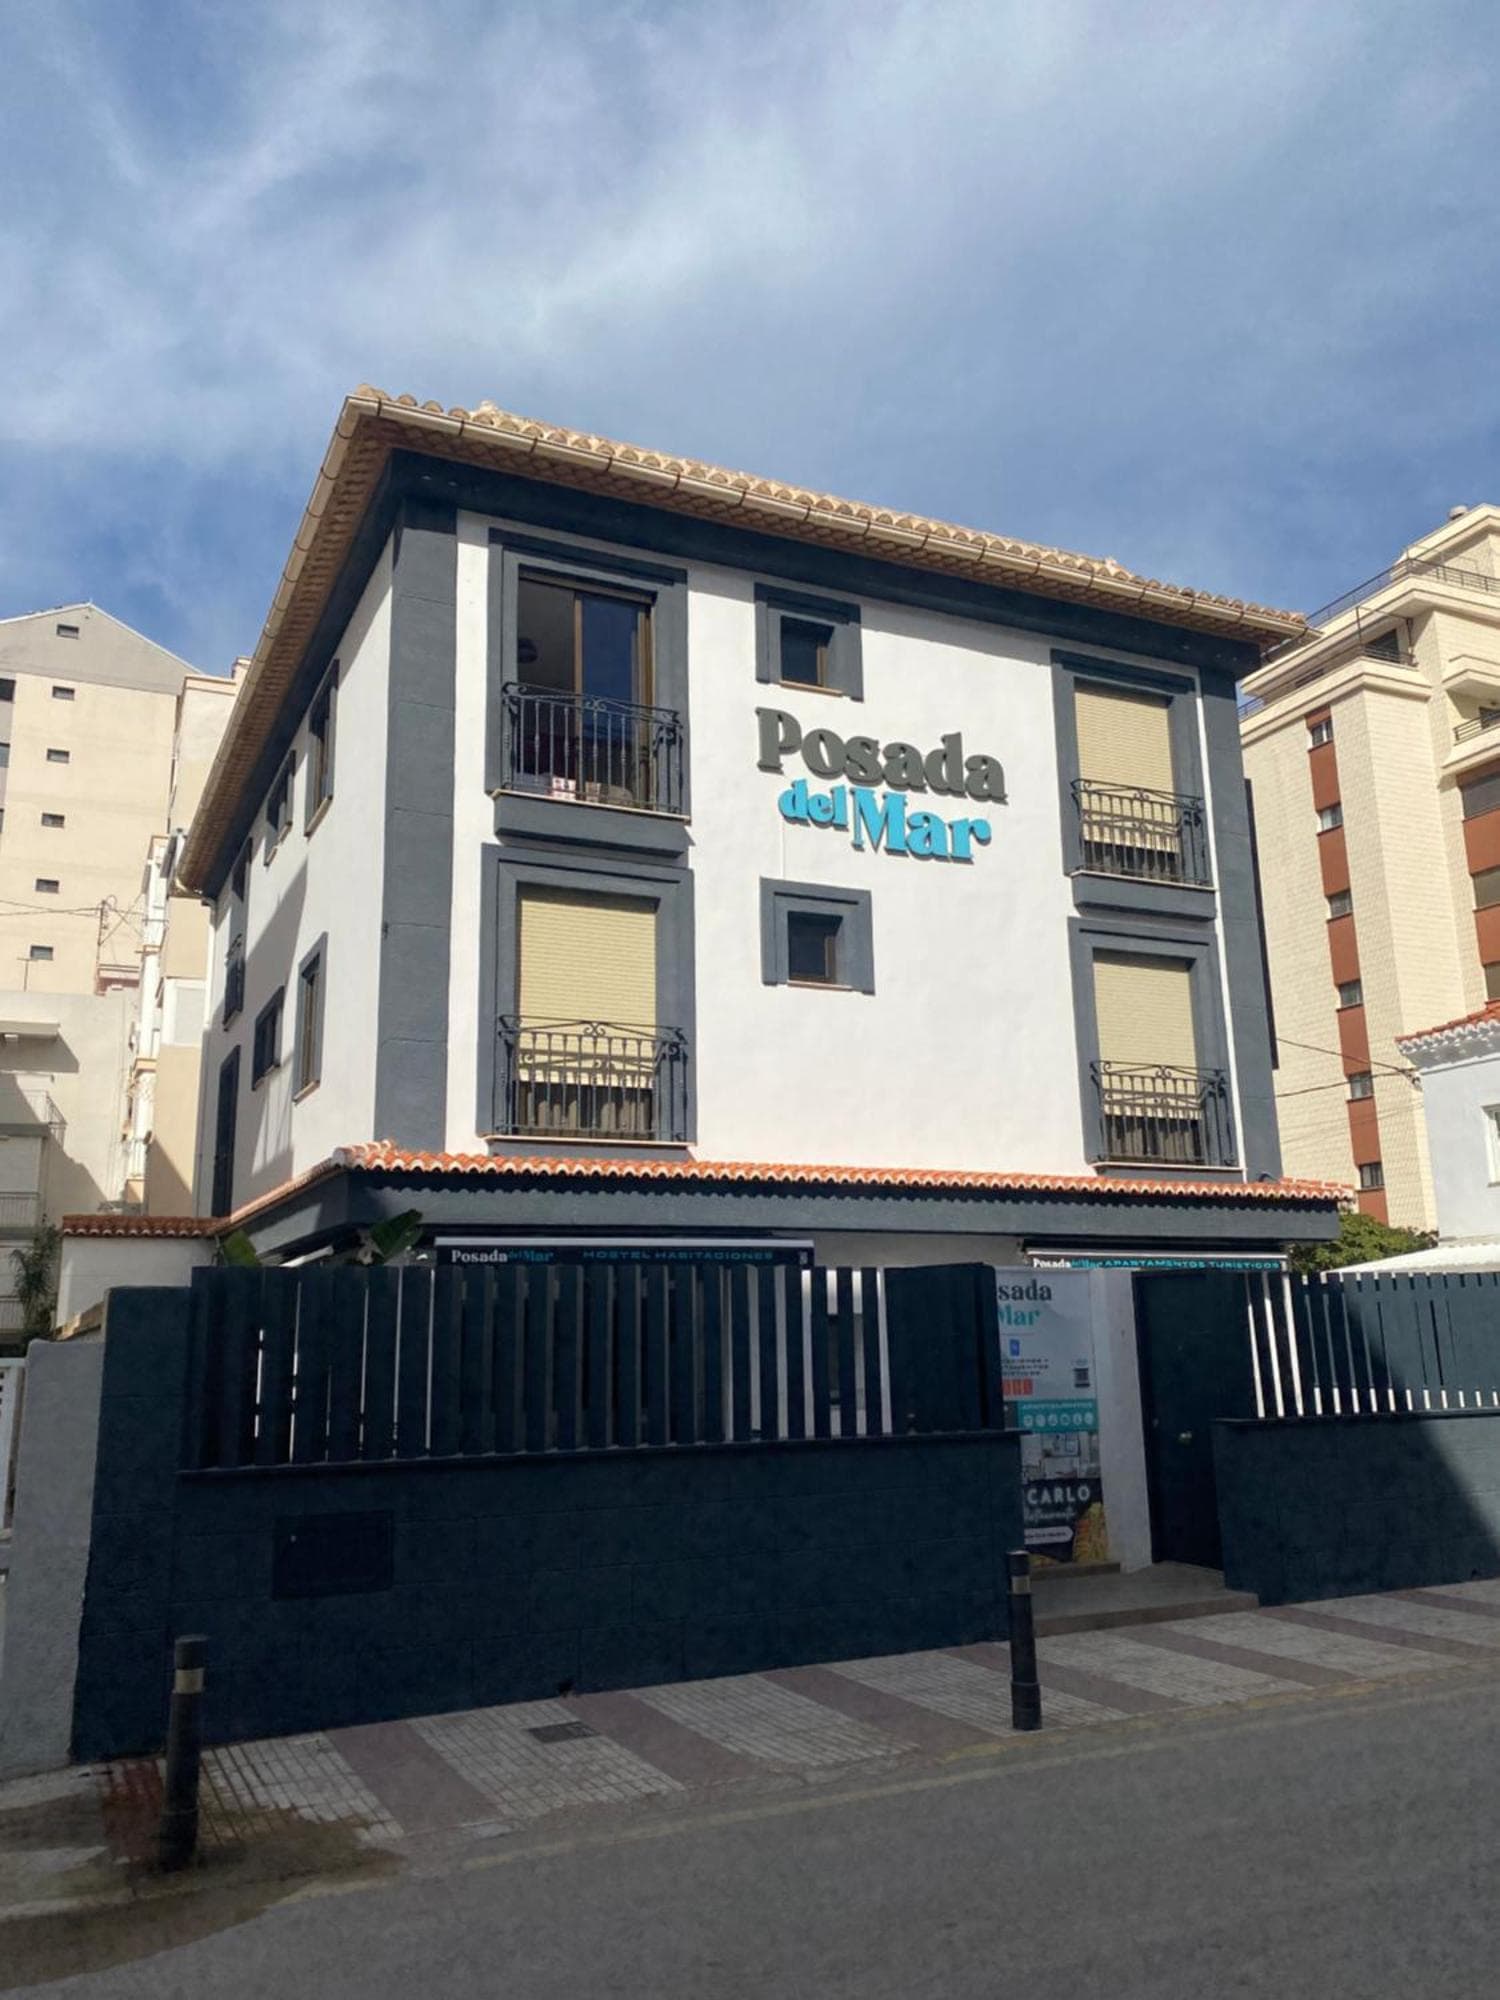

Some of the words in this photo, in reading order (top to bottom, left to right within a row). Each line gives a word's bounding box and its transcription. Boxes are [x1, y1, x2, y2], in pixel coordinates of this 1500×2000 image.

[755, 706, 1008, 805] Posada
[778, 779, 849, 832] del
[849, 787, 992, 865] Mar
[451, 1249, 508, 1263] Posada
[583, 1250, 651, 1260] HOSTEL
[654, 1250, 773, 1261] HABITACIONES
[998, 1279, 1052, 1301] sada
[1027, 1484, 1091, 1505] CARLO
